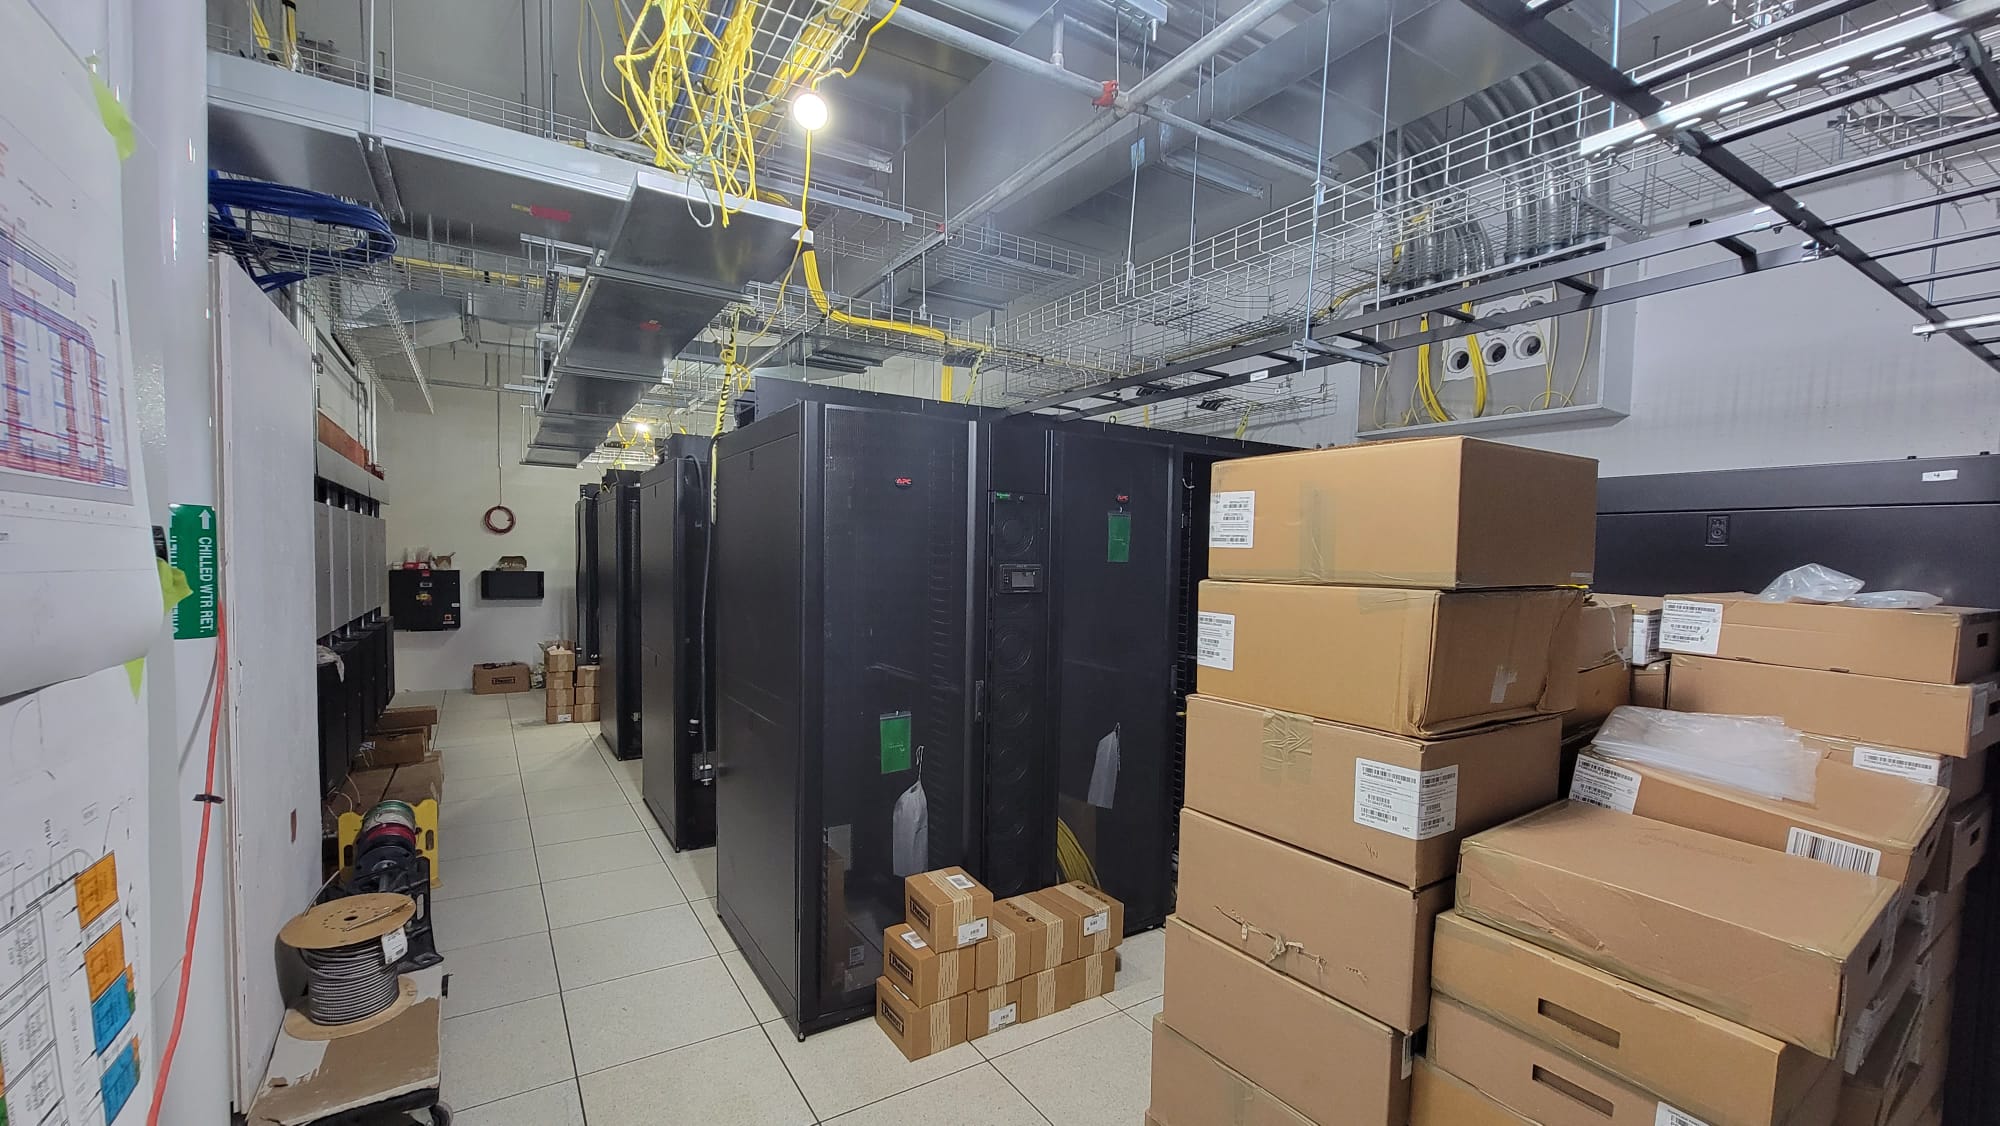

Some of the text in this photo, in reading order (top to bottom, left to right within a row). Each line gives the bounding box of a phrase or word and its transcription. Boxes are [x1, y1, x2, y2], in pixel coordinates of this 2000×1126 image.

[198, 536, 214, 633] CHILLED WTR RET.
